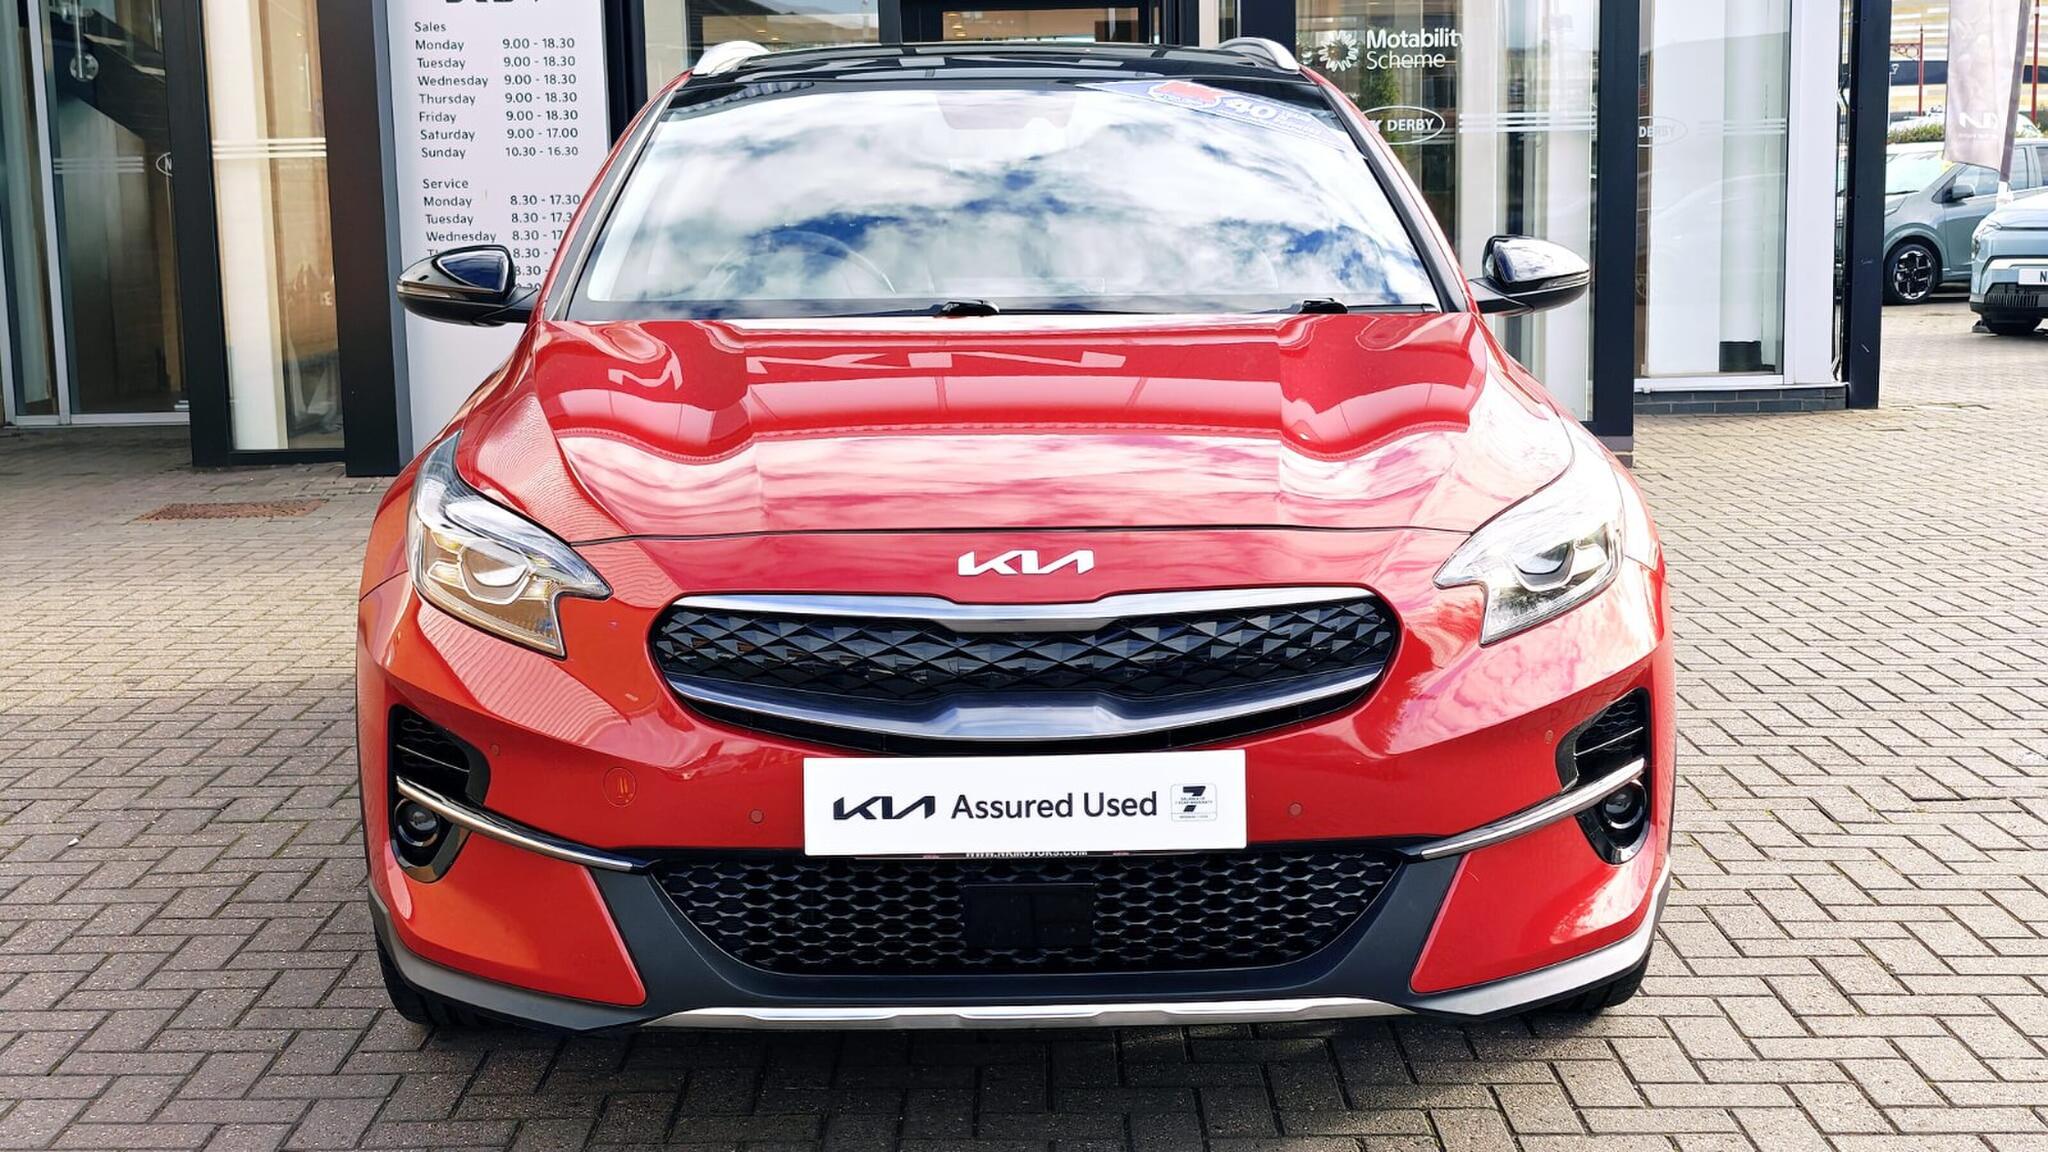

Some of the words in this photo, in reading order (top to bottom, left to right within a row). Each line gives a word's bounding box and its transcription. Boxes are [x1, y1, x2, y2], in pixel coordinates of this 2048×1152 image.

[415, 22, 446, 32] Sales
[416, 40, 464, 51] Monday
[503, 38, 529, 49] 9.00
[542, 38, 574, 48] 18.30
[1366, 28, 1465, 50] Motability
[417, 58, 465, 70] Tuesday
[504, 56, 530, 67] 9.00
[544, 56, 575, 66] 18.30
[1366, 50, 1446, 71] Scheme
[417, 76, 488, 87] Wednesday
[504, 75, 531, 85] 9.00
[544, 74, 576, 84] 18.30
[419, 94, 475, 106] Thursday
[505, 93, 532, 103] 9.00
[545, 92, 577, 102] 18.30
[419, 112, 456, 123] Friday
[506, 111, 533, 121] 9.00
[546, 110, 578, 120] 18.30
[1387, 118, 1434, 132] DERBY
[421, 130, 475, 141] Saturday
[507, 129, 534, 138] 9.00
[547, 128, 578, 138] 17.00
[422, 147, 465, 159] Sunday
[506, 147, 536, 156] 10.30
[548, 146, 578, 156] 16.30
[423, 179, 468, 189] Service
[424, 197, 471, 206] Monday
[511, 195, 537, 205] 8.30
[425, 214, 473, 225] Tuesday
[512, 213, 538, 223] 8.30
[426, 231, 496, 243] Wednesday
[512, 230, 539, 240] 8.30
[513, 248, 540, 258] 8.30
[957, 549, 1095, 576] KIA
[833, 796, 936, 820] KIA
[951, 794, 1073, 819] Assured
[1084, 792, 1157, 817] Used
